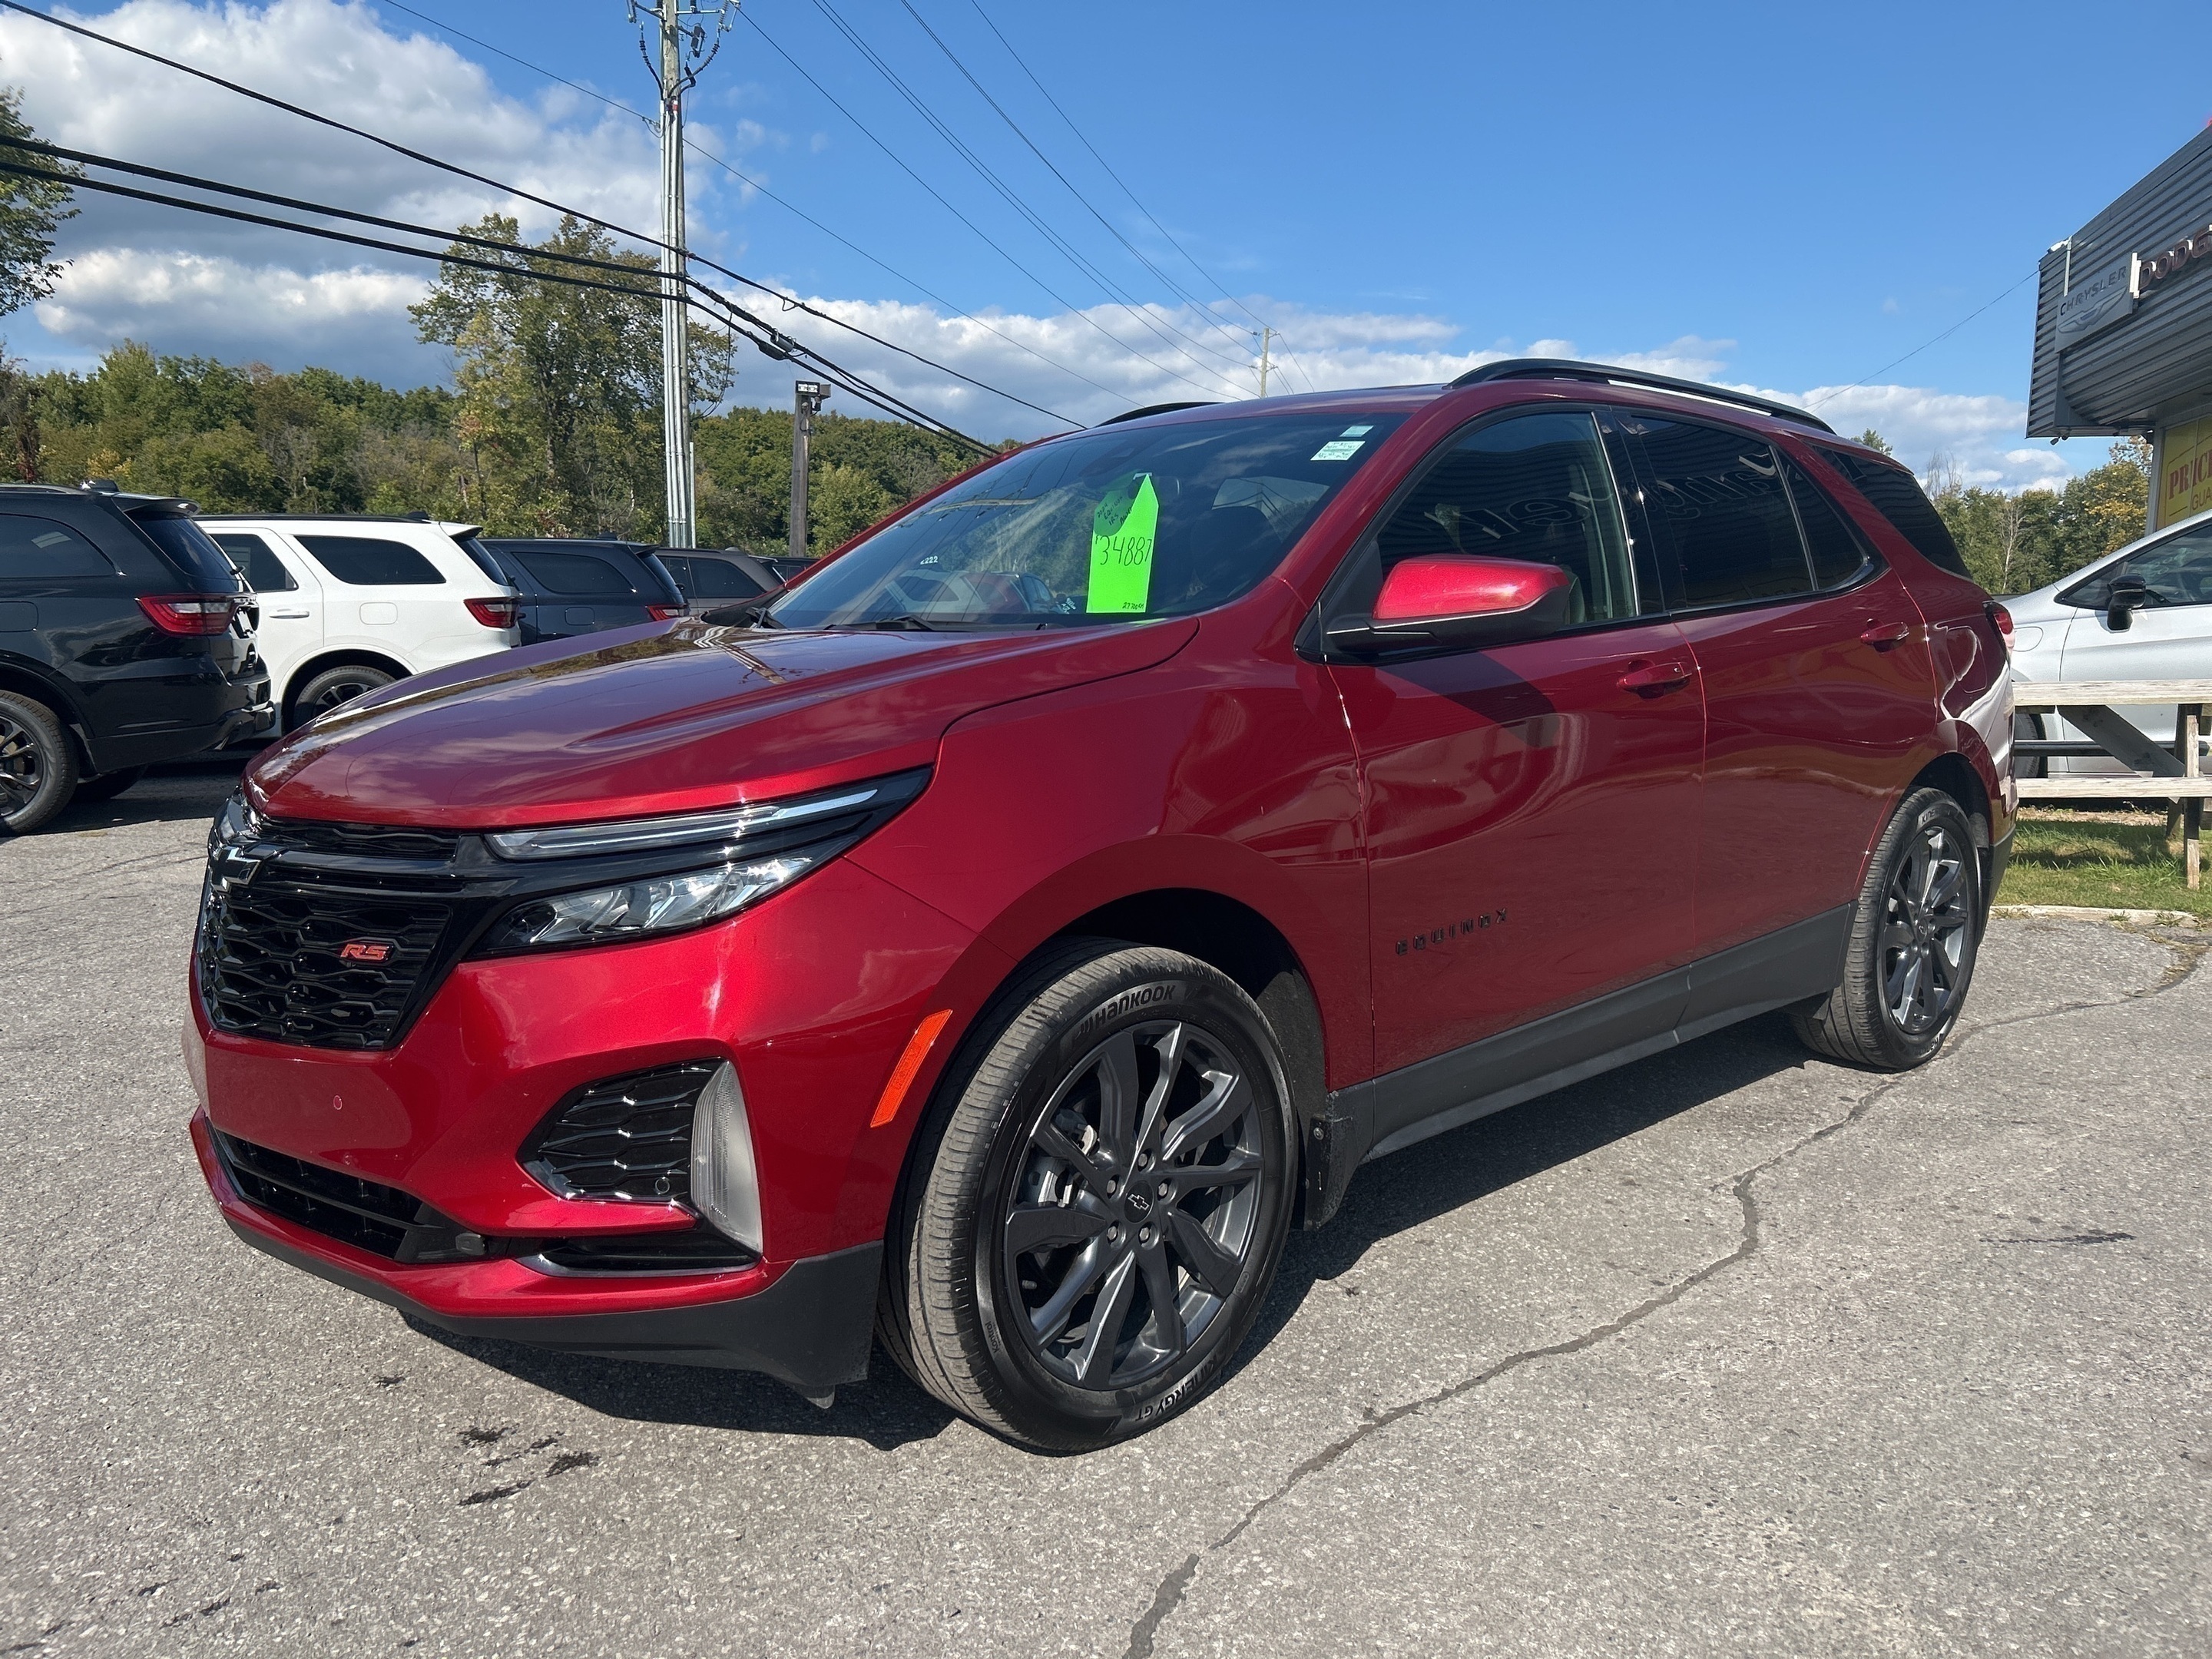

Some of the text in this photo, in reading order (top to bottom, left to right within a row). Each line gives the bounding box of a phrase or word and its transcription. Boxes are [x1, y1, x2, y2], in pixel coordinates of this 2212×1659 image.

[2060, 266, 2127, 316] CHRYSLER
[340, 943, 389, 961] RS
[1396, 908, 1507, 955] EQUINOX
[1135, 1355, 1218, 1422] KINERGY GT
